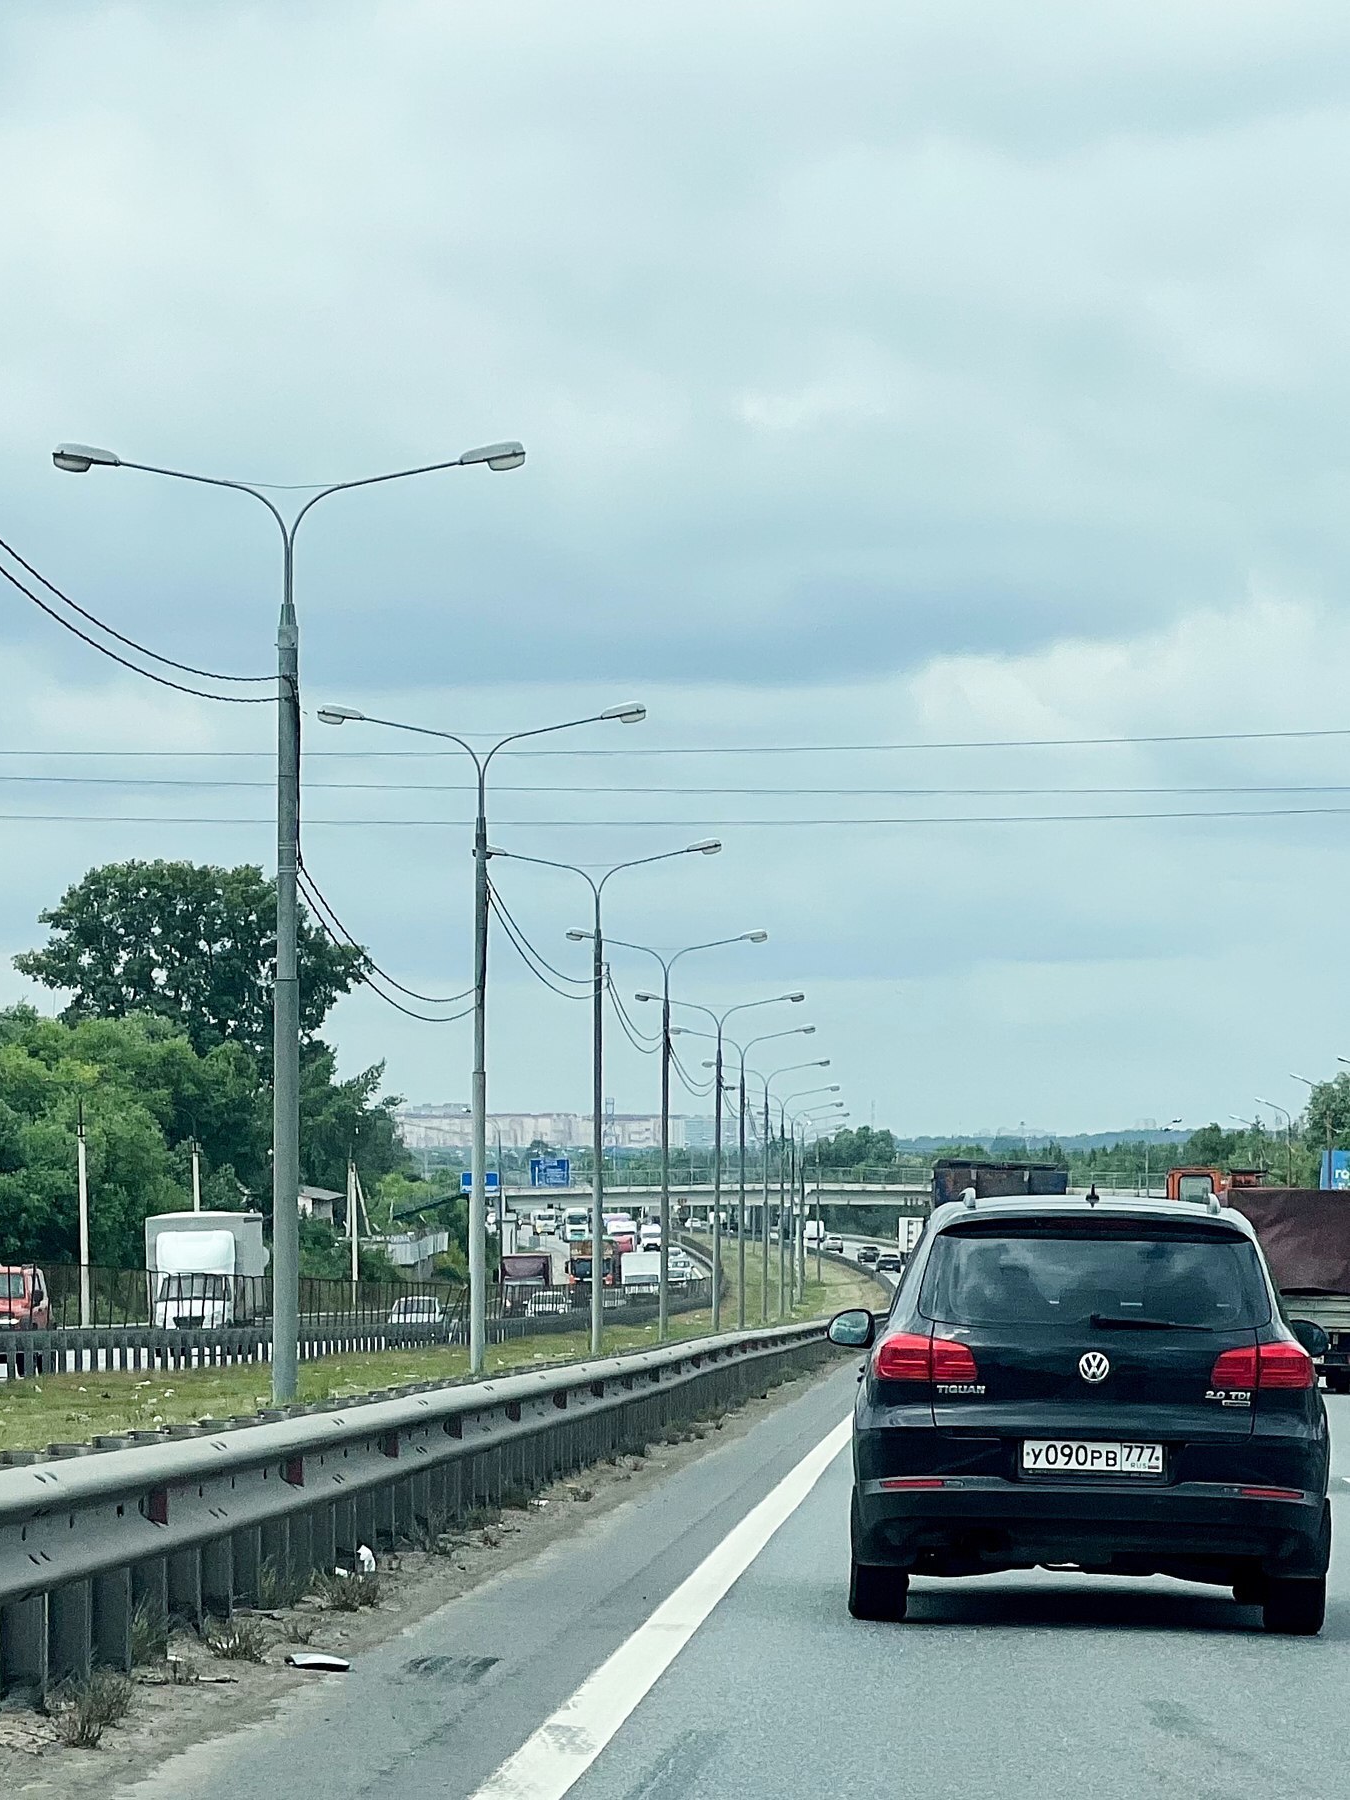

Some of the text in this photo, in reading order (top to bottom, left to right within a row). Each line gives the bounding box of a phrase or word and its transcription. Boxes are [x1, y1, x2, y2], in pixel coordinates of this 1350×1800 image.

[936, 1384, 986, 1394] TIGUAN
[1229, 1391, 1251, 1400] TDI
[1123, 1445, 1156, 1463] 777
[1130, 1462, 1148, 1470] RUS
